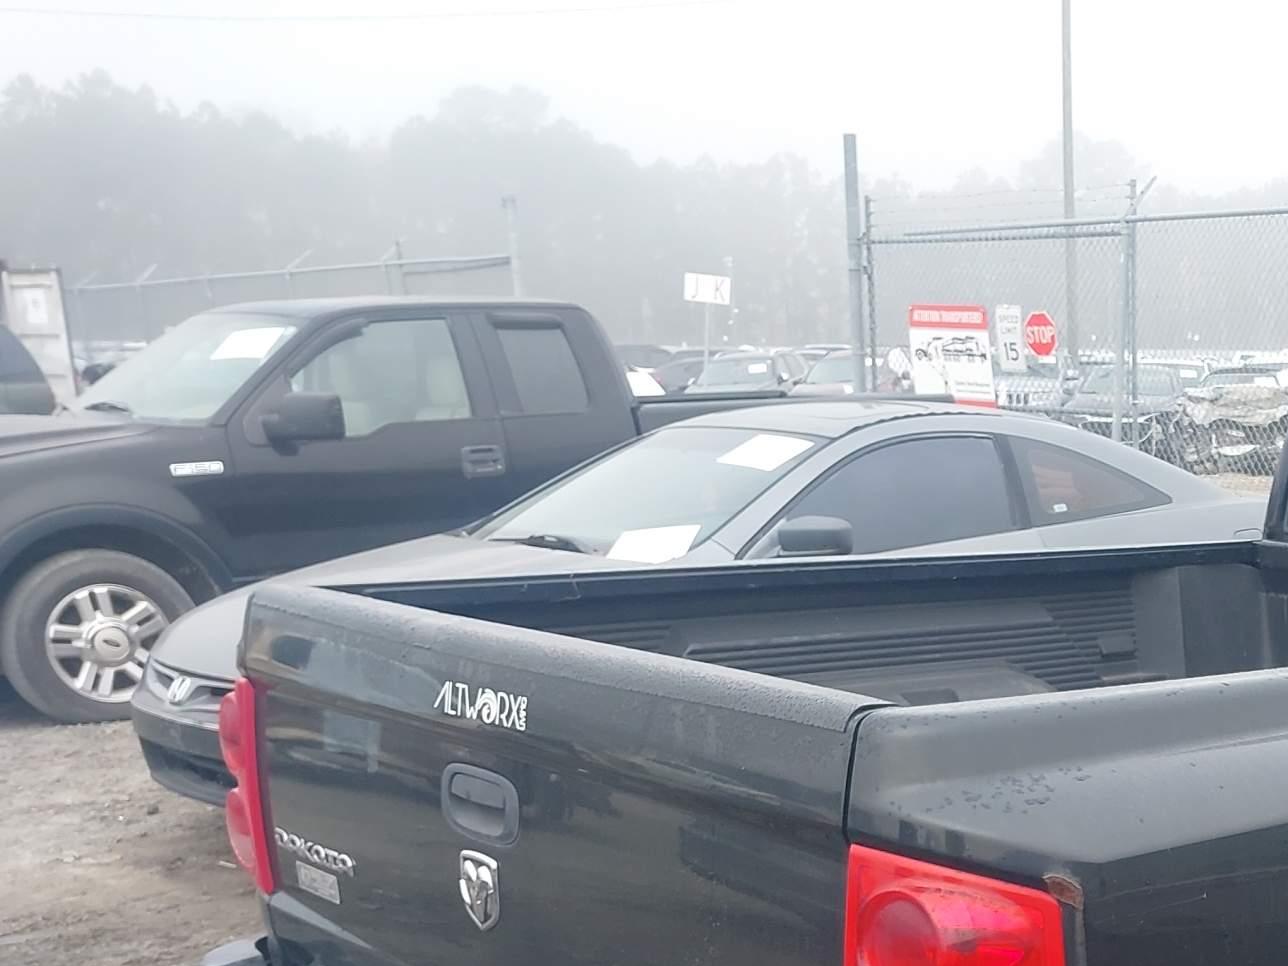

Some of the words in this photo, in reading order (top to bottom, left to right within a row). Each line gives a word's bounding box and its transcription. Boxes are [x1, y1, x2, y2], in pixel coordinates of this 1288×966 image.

[714, 279, 726, 303] K
[998, 314, 1018, 324] SPEED
[1026, 325, 1055, 345] STOP
[1003, 341, 1020, 362] 15
